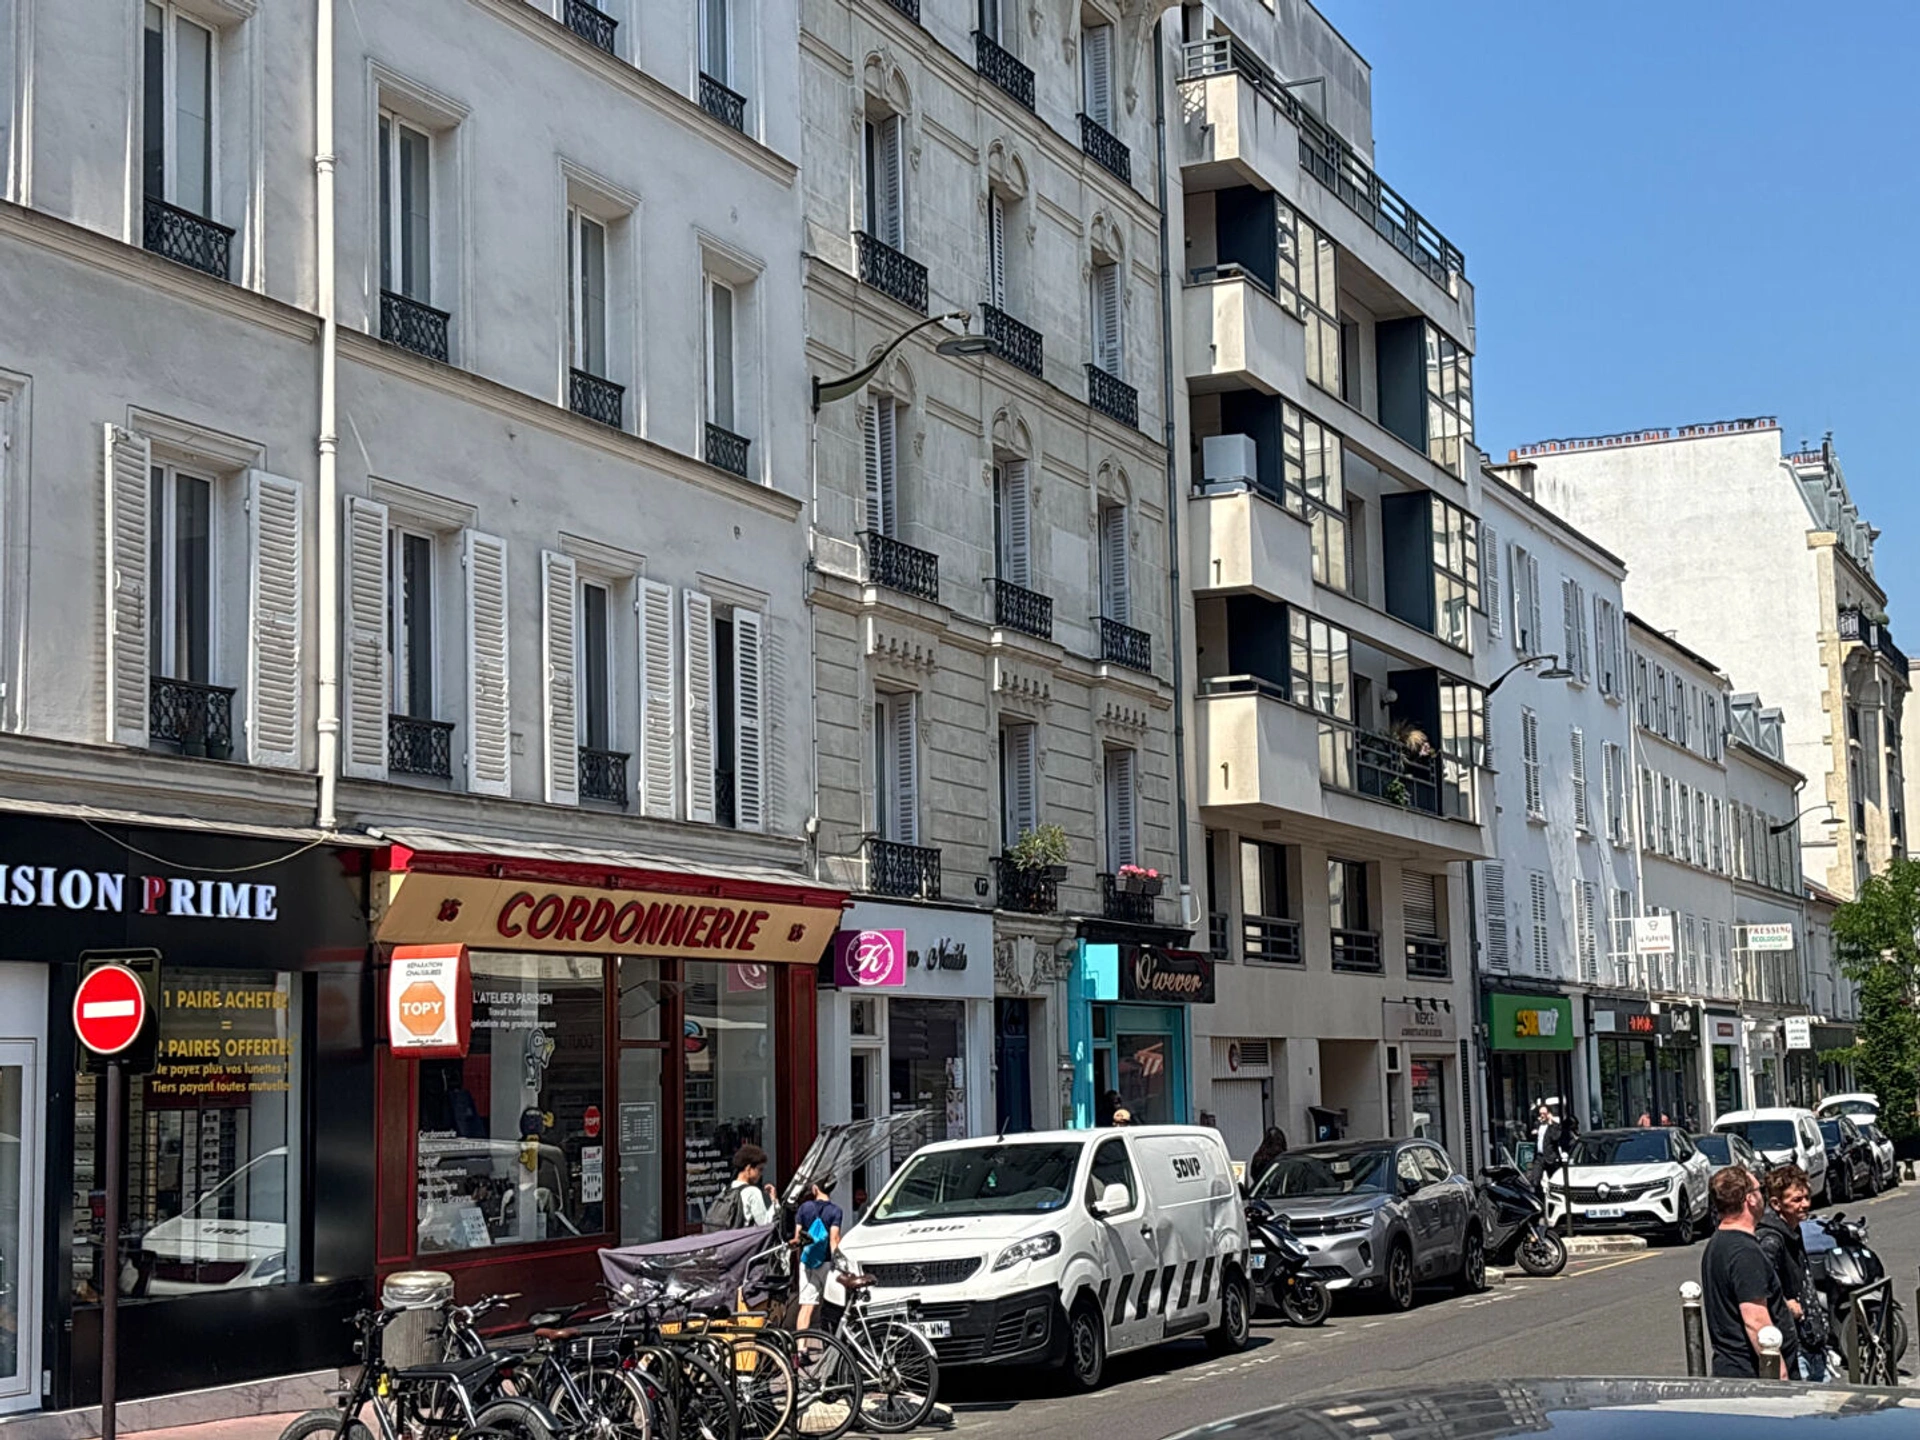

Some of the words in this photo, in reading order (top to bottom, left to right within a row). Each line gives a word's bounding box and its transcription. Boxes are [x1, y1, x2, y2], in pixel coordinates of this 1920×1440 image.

[139, 875, 278, 920] PRIME
[497, 891, 769, 951] CORDONNERIE
[177, 990, 220, 1008] PAIRE
[472, 991, 514, 1004] L'ATELIER
[516, 992, 553, 1005] PARISIEN
[402, 1001, 442, 1016] TOPY
[168, 1039, 220, 1057] PAIRES
[170, 1065, 200, 1078] payez
[202, 1062, 223, 1077] plus
[226, 1066, 242, 1074] vos
[244, 1062, 281, 1074] lunettes
[152, 1080, 176, 1093] Tiers
[179, 1080, 214, 1095] payant
[217, 1080, 246, 1092] toutes
[1172, 1157, 1202, 1179] SDVP
[907, 1225, 965, 1235] SDVP
